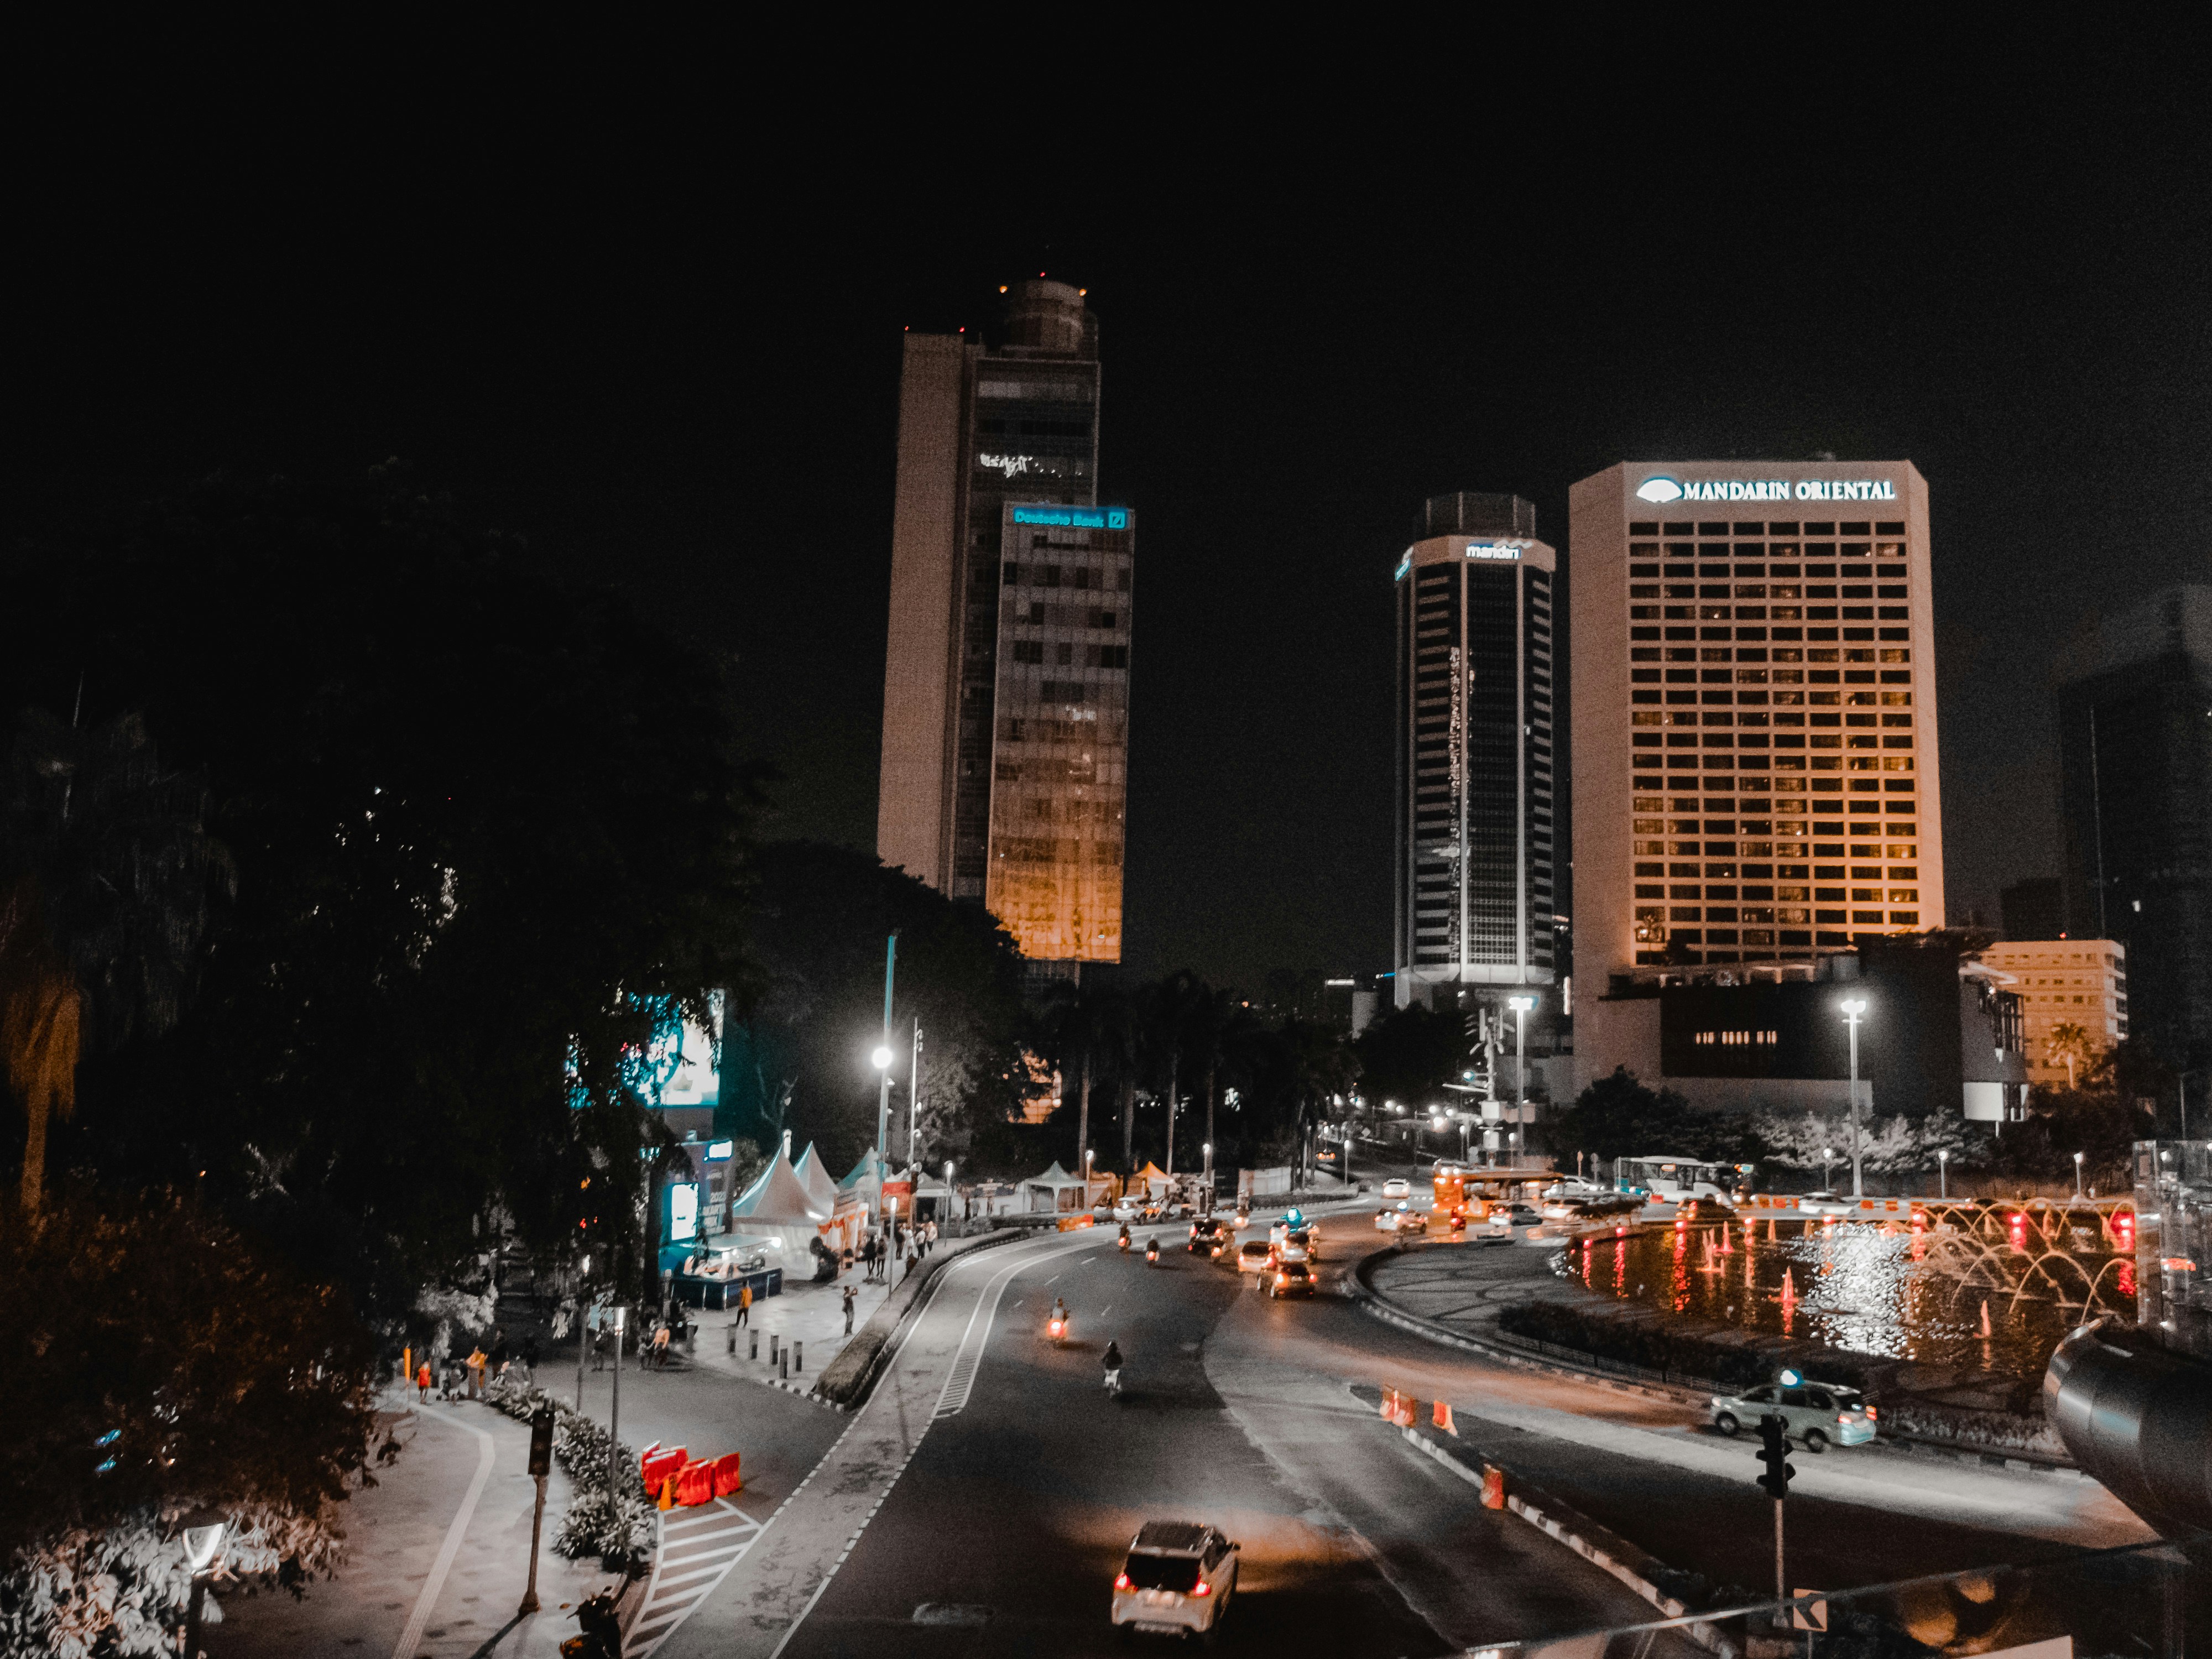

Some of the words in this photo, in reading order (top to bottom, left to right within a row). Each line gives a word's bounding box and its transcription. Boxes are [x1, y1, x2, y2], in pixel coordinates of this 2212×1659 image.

[1683, 481, 1791, 500] MANDARIN
[1795, 480, 1895, 500] ORIENTAL
[1015, 512, 1071, 525] Deutsche
[1073, 515, 1104, 527] Bank
